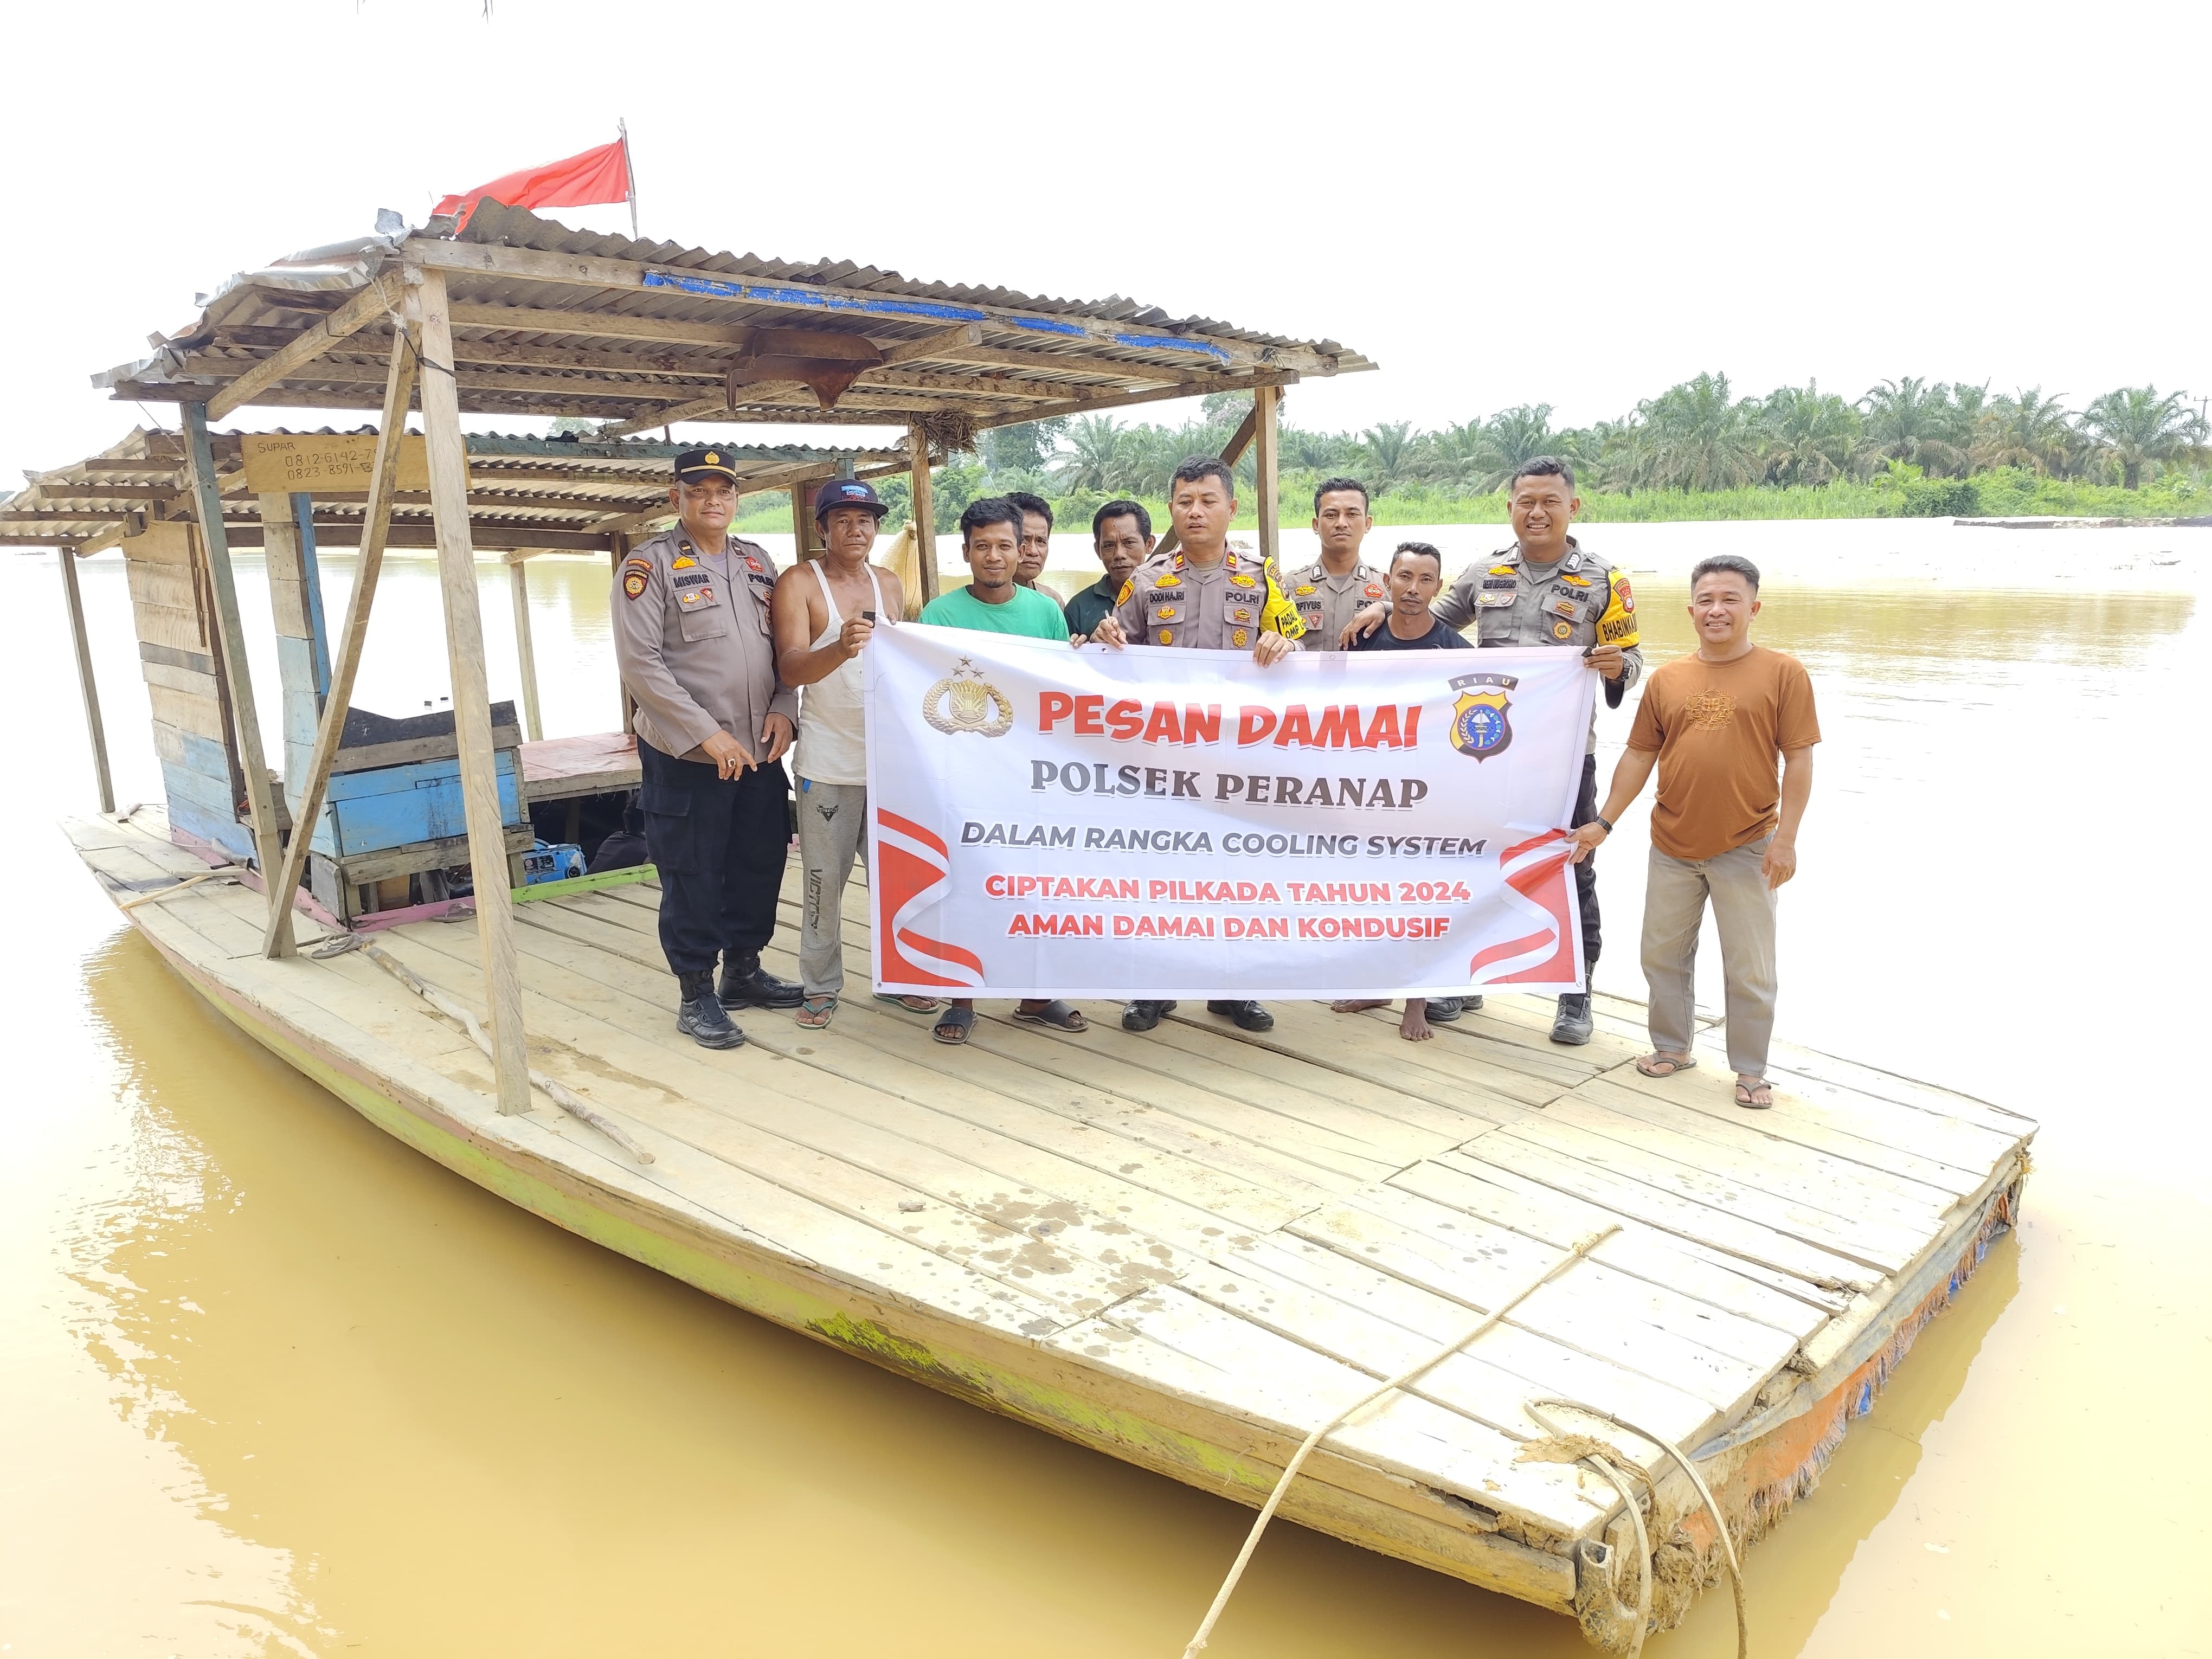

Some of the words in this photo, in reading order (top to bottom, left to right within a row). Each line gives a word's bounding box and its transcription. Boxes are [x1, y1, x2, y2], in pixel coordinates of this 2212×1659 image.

[258, 442, 295, 453] SUPAR
[673, 574, 710, 588] MISWAR
[1149, 593, 1165, 603] DODI
[1165, 591, 1185, 601] HAJRI
[1225, 591, 1259, 604] POLRI
[1551, 584, 1589, 602] POLRI
[1296, 600, 1322, 612] RFIYUS
[1281, 609, 1298, 629] PADAL
[1457, 677, 1510, 686] RIAU
[1038, 691, 1222, 745] PESAN
[1237, 704, 1422, 749] DAMAI
[1031, 760, 1201, 796] POLSEK
[1216, 773, 1428, 808] PERANAP
[960, 822, 1076, 847] DALAM
[1084, 828, 1213, 852] RANGKA
[1222, 833, 1359, 855] COOLING
[1366, 836, 1487, 855] SYSTEM
[985, 875, 1139, 898] CIPTAKAN
[1149, 880, 1281, 901] PILKADA
[1287, 883, 1391, 902] TAHUN
[1398, 882, 1471, 902] 2024
[1008, 914, 1103, 936] AMAN
[1113, 915, 1214, 937] DAMAI
[1224, 917, 1289, 937] DAN
[1301, 917, 1449, 938] KONDUSIF
